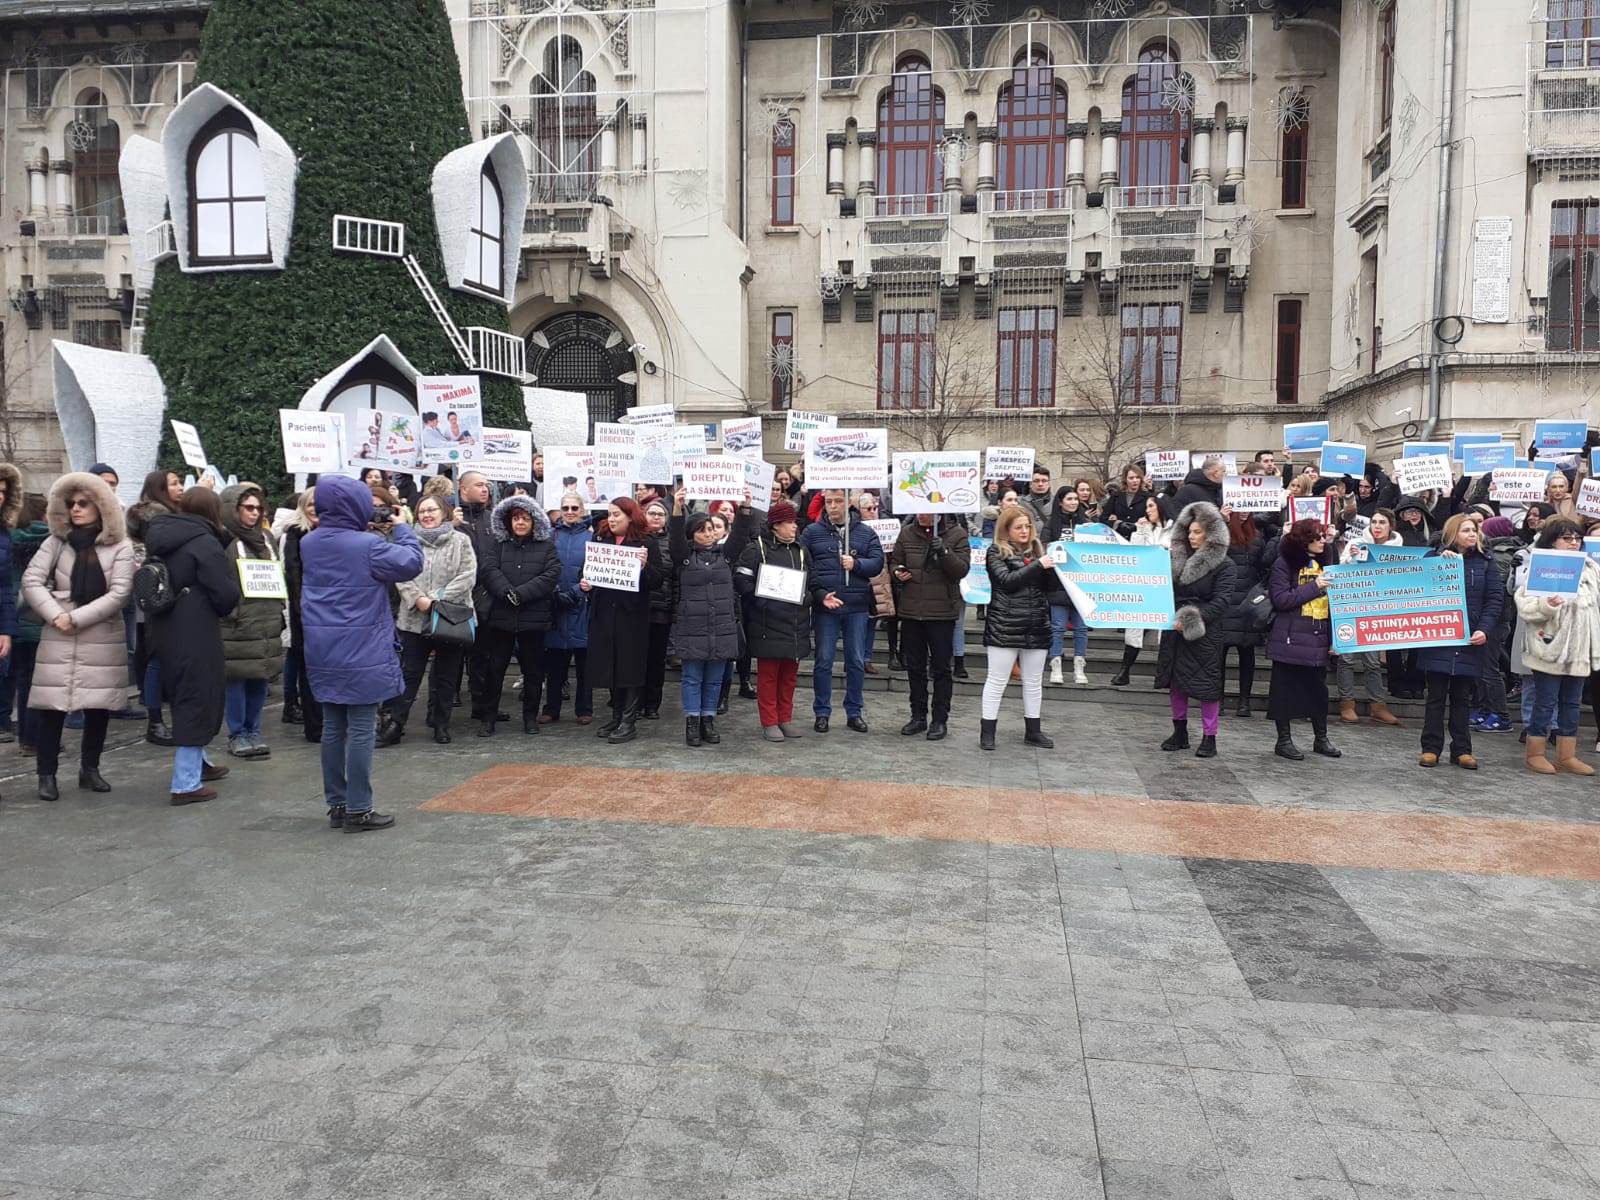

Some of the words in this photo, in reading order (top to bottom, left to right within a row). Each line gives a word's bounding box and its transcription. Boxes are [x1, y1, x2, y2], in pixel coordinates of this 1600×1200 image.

[810, 414, 829, 422] POATE
[790, 432, 799, 440] CU
[1158, 452, 1176, 460] NU
[692, 474, 737, 482] DREPTUL
[1242, 478, 1262, 486] NU
[1578, 504, 1586, 512] LA
[614, 550, 640, 558] POATE
[588, 556, 626, 566] CALITATE
[1080, 554, 1137, 565] CABINETELE
[247, 581, 280, 592] FALIMENT
[1384, 588, 1424, 596] PRIMARIAT
[1402, 598, 1461, 608] UNIVERSITARE
[1100, 612, 1112, 620] DE
[1114, 610, 1168, 622] ÎNCHIDERE
[1360, 620, 1368, 632] ȘI
[1372, 618, 1409, 630] ȘTIINȚA
[1412, 612, 1460, 626] NOASTRĂ
[1365, 628, 1423, 642] VALOREAZĂ
[1426, 629, 1436, 638] 11
[1440, 628, 1456, 636] LEI
